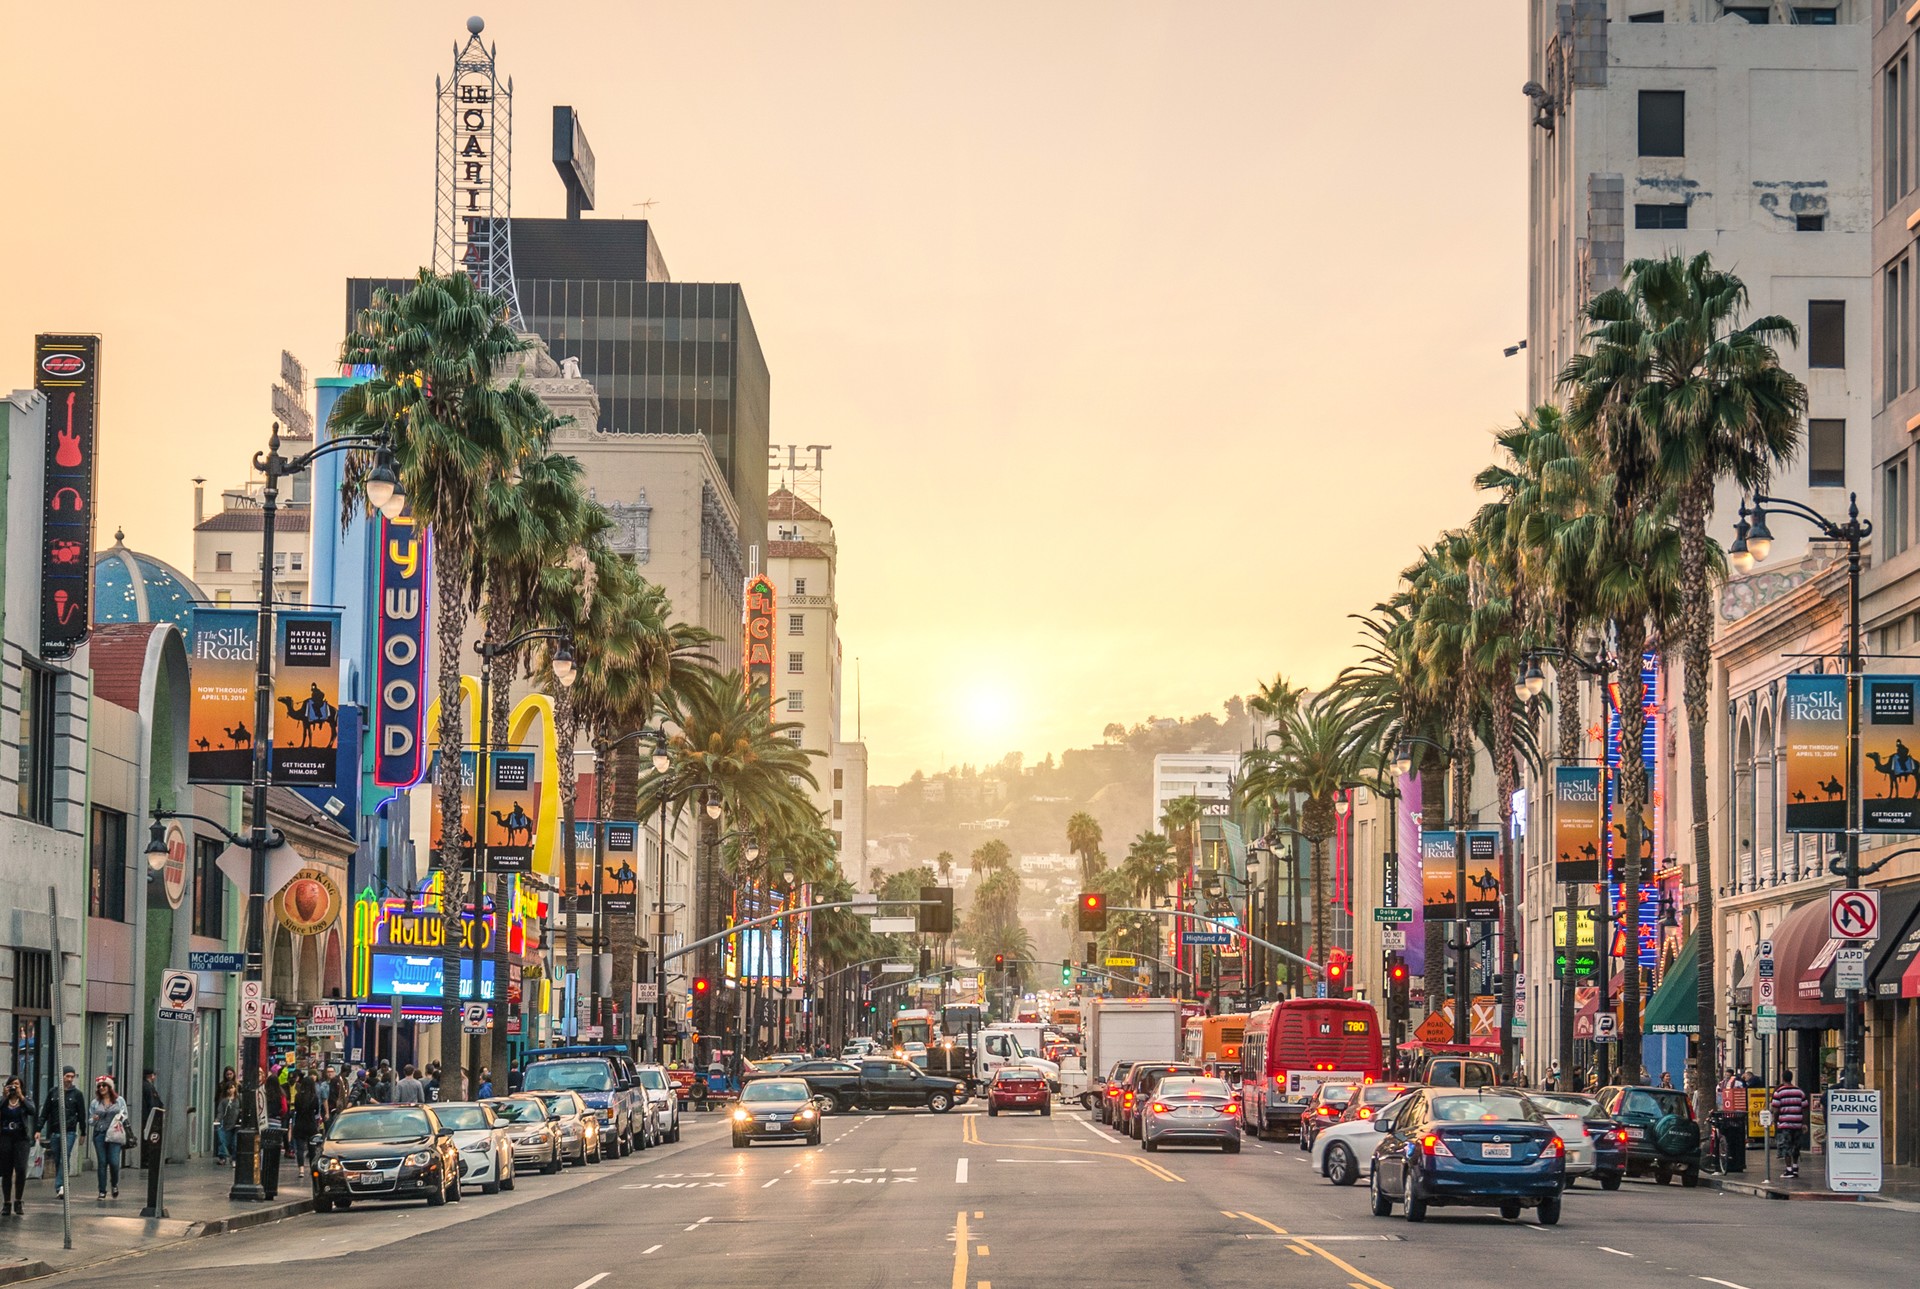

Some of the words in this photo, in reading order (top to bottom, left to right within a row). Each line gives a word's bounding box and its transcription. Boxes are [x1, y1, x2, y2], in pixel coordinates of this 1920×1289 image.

[750, 593, 772, 614] EL
[203, 630, 217, 640] The
[217, 628, 249, 647] Silk
[203, 640, 254, 661] Road
[1797, 694, 1808, 702] The
[1808, 691, 1839, 708] Silk
[1797, 702, 1843, 720] Road
[1572, 779, 1594, 792] Silk
[1563, 787, 1598, 801] Road
[1435, 841, 1452, 851] Silk
[1428, 846, 1455, 858] Road
[315, 872, 336, 896] KING
[284, 918, 306, 934] Since
[309, 920, 328, 934] 1989
[389, 914, 490, 950] HOLLYOOD
[1186, 934, 1216, 943] Highland
[191, 953, 235, 964] McCadden
[175, 1013, 193, 1021] HERE
[315, 1007, 336, 1018] ATM
[1321, 1024, 1330, 1033] M
[1347, 1021, 1365, 1032] 780
[1652, 1024, 1676, 1033] CAMERAS
[1831, 1094, 1877, 1103] PUBLIC
[1831, 1104, 1877, 1113] PARKING
[1834, 1141, 1847, 1149] PARK
[1848, 1141, 1860, 1149] LOCK
[1862, 1141, 1875, 1149] WALK
[810, 1176, 918, 1185] XING
